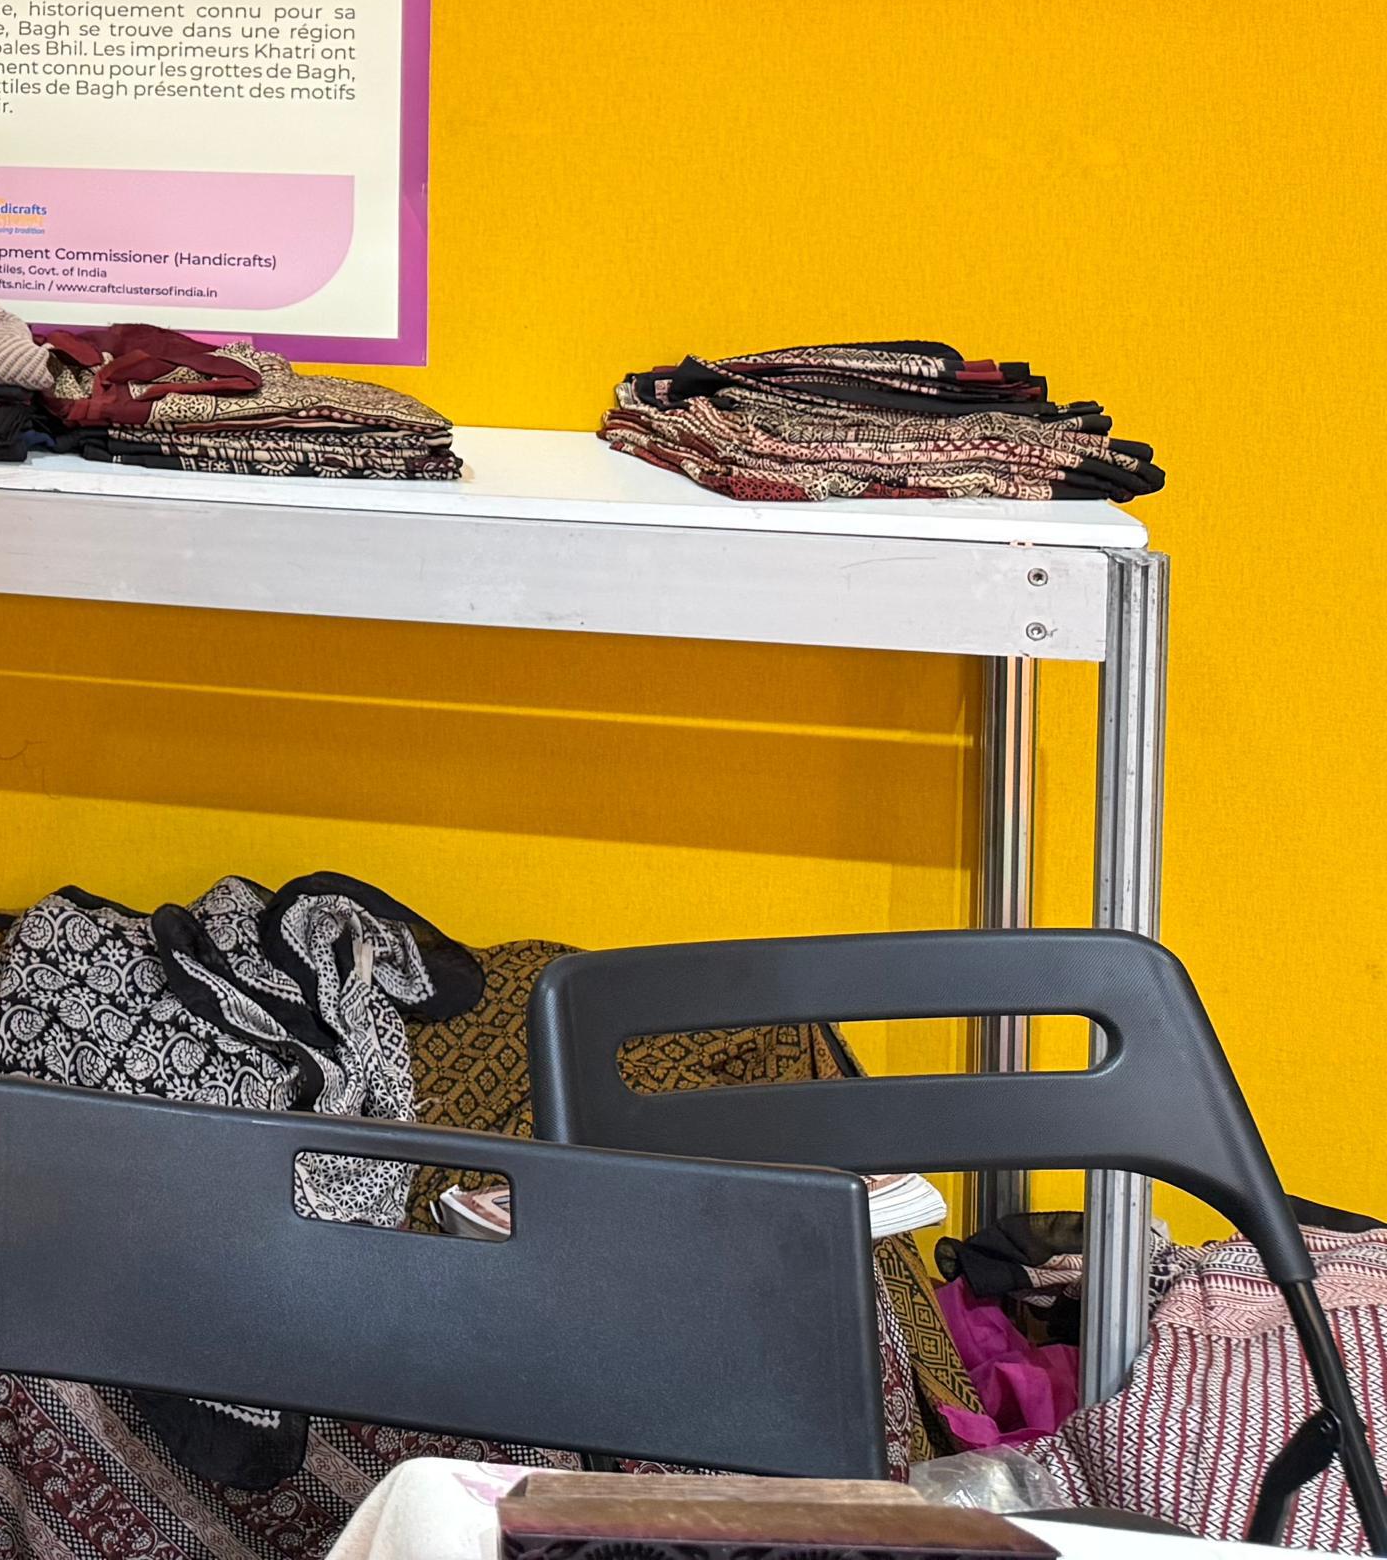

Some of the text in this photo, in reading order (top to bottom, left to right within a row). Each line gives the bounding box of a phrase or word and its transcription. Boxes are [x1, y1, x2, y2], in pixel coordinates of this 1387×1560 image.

[42, 63, 104, 75] connu
[109, 64, 155, 79] pour
[160, 61, 186, 77] les
[189, 64, 262, 80] grottes
[266, 62, 291, 78] de
[296, 63, 355, 83] Bagh,
[45, 79, 70, 94] de
[76, 80, 127, 99] Bagh
[133, 81, 244, 99] présentent
[249, 83, 285, 98] des
[290, 84, 355, 100] motifs
[54, 247, 169, 263] Commissioner
[174, 252, 276, 269] (Handicrafts)
[28, 265, 59, 276] Govt.
[61, 266, 74, 276] of
[77, 267, 107, 277] India
